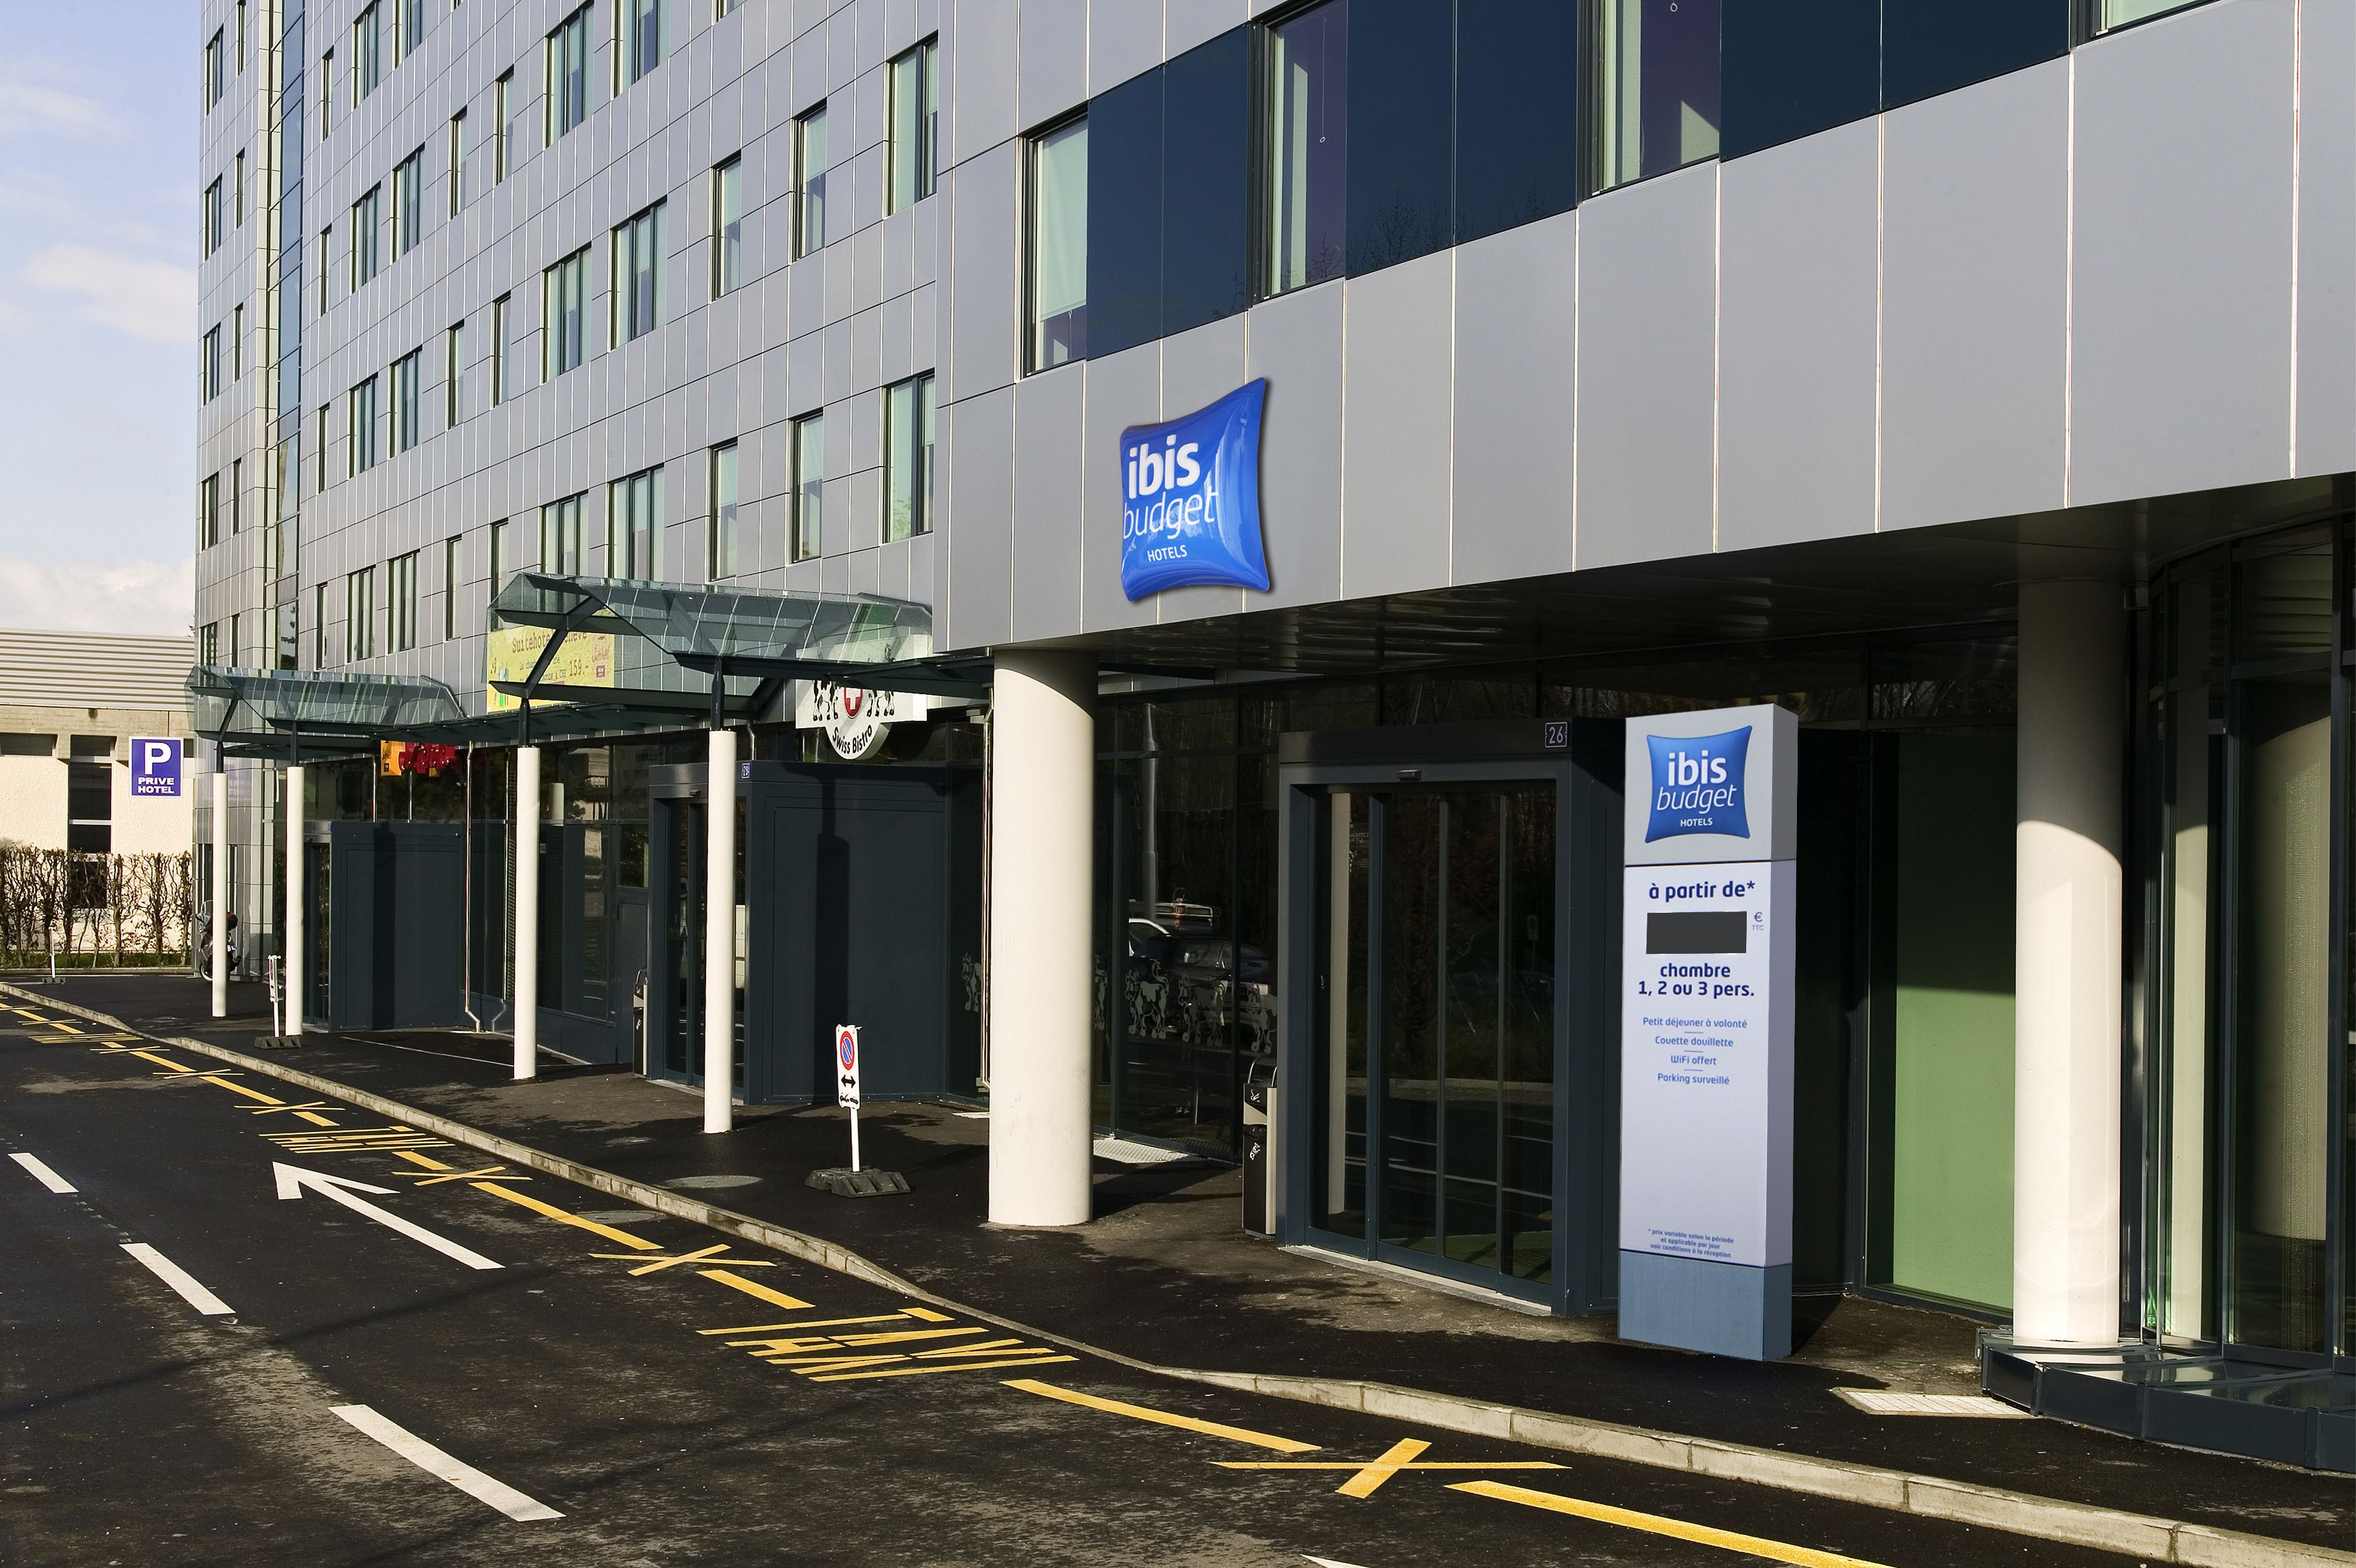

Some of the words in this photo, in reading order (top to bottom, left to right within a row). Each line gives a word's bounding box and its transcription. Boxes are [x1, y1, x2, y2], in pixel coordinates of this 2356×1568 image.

[1129, 434, 1200, 500] ibis
[1123, 485, 1219, 539] budget
[1147, 545, 1188, 562] HOTELS
[512, 629, 553, 653] Suitehote
[832, 726, 851, 755] Swiss
[852, 724, 873, 753] Bistro
[1549, 726, 1563, 744] 26
[144, 742, 172, 775] P
[1668, 750, 1727, 787] ibis
[137, 777, 174, 785] PRIVE
[137, 785, 174, 794] HOTEL
[1656, 784, 1737, 814] budget
[1680, 817, 1713, 827] HOTELS
[1649, 883, 1659, 899] à
[1665, 881, 1716, 902] partir
[1754, 912, 1762, 922] €
[1660, 963, 1731, 977] chambre
[1639, 980, 1652, 996] 1,
[1658, 980, 1667, 995] 2
[1673, 984, 1692, 995] ou
[1698, 981, 1707, 995] 3
[1714, 984, 1754, 999] pers.
[1643, 1017, 1663, 1025] Petit
[1665, 1018, 1703, 1028] déjeuner
[1706, 1018, 1711, 1027] à
[1714, 1020, 1747, 1028] volonté
[1655, 1036, 1688, 1045] Couette
[1691, 1037, 1734, 1047] douillette
[1692, 1056, 1717, 1065] offert
[1658, 1073, 1690, 1084] Parking
[1693, 1075, 1730, 1085] surveillé
[1668, 1237, 1697, 1247] applicable
[1662, 1244, 1691, 1253] conditions
[1704, 1249, 1731, 1258] réception
[695, 1307, 1080, 1382] TAXI
